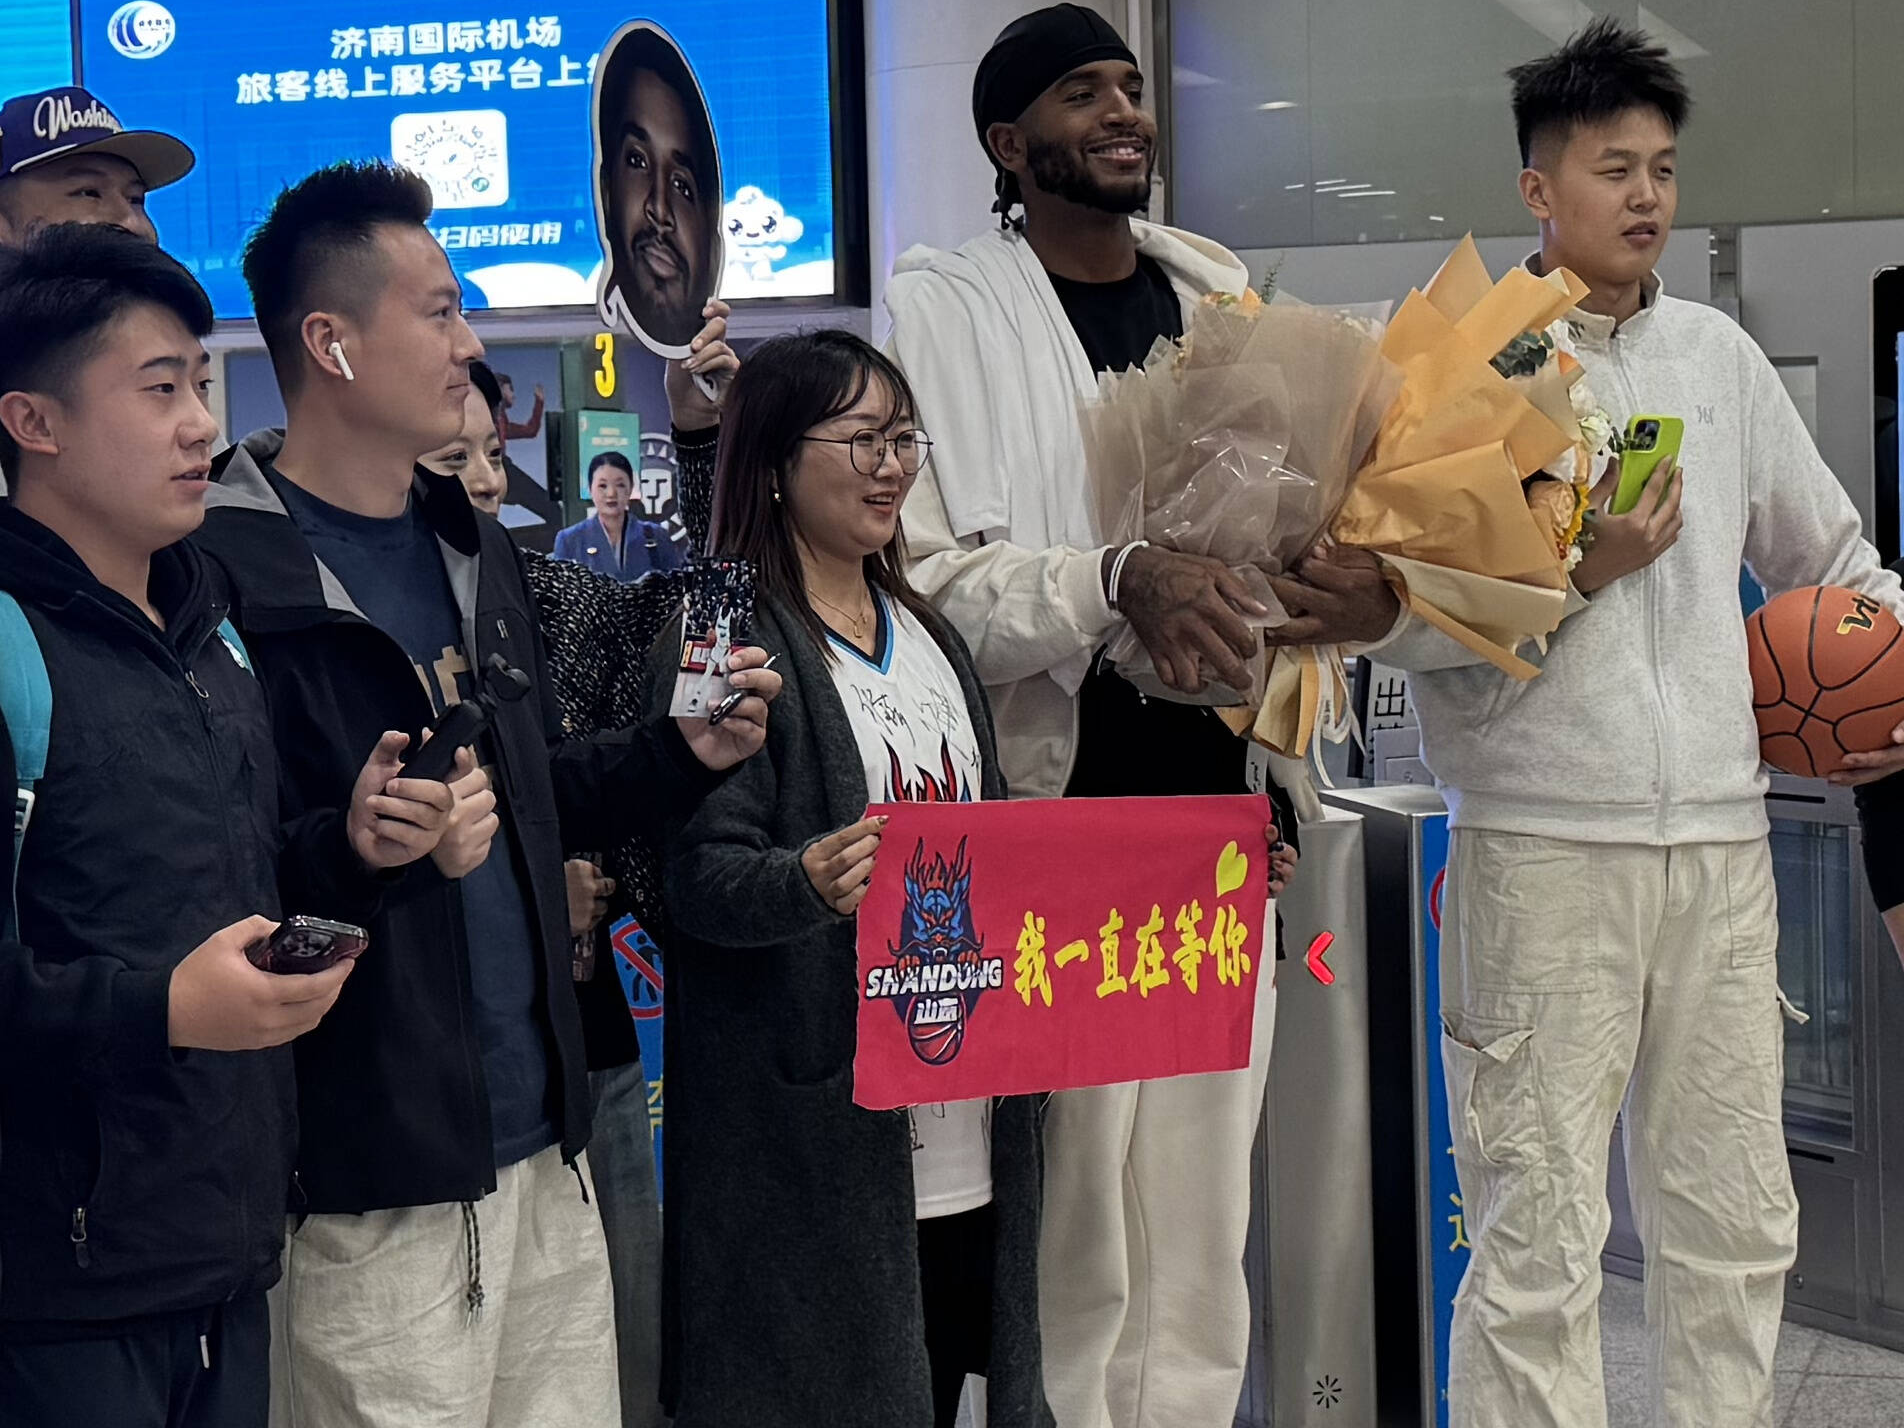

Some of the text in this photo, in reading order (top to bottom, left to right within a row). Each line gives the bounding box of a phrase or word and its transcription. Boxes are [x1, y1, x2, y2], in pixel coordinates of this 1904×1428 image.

[329, 16, 562, 60] 济南国际机场
[429, 222, 562, 249] 扫码使用
[594, 332, 616, 399] 3
[1013, 899, 1252, 1009] 我一直在等你
[864, 958, 1004, 1000] SHANDONG
